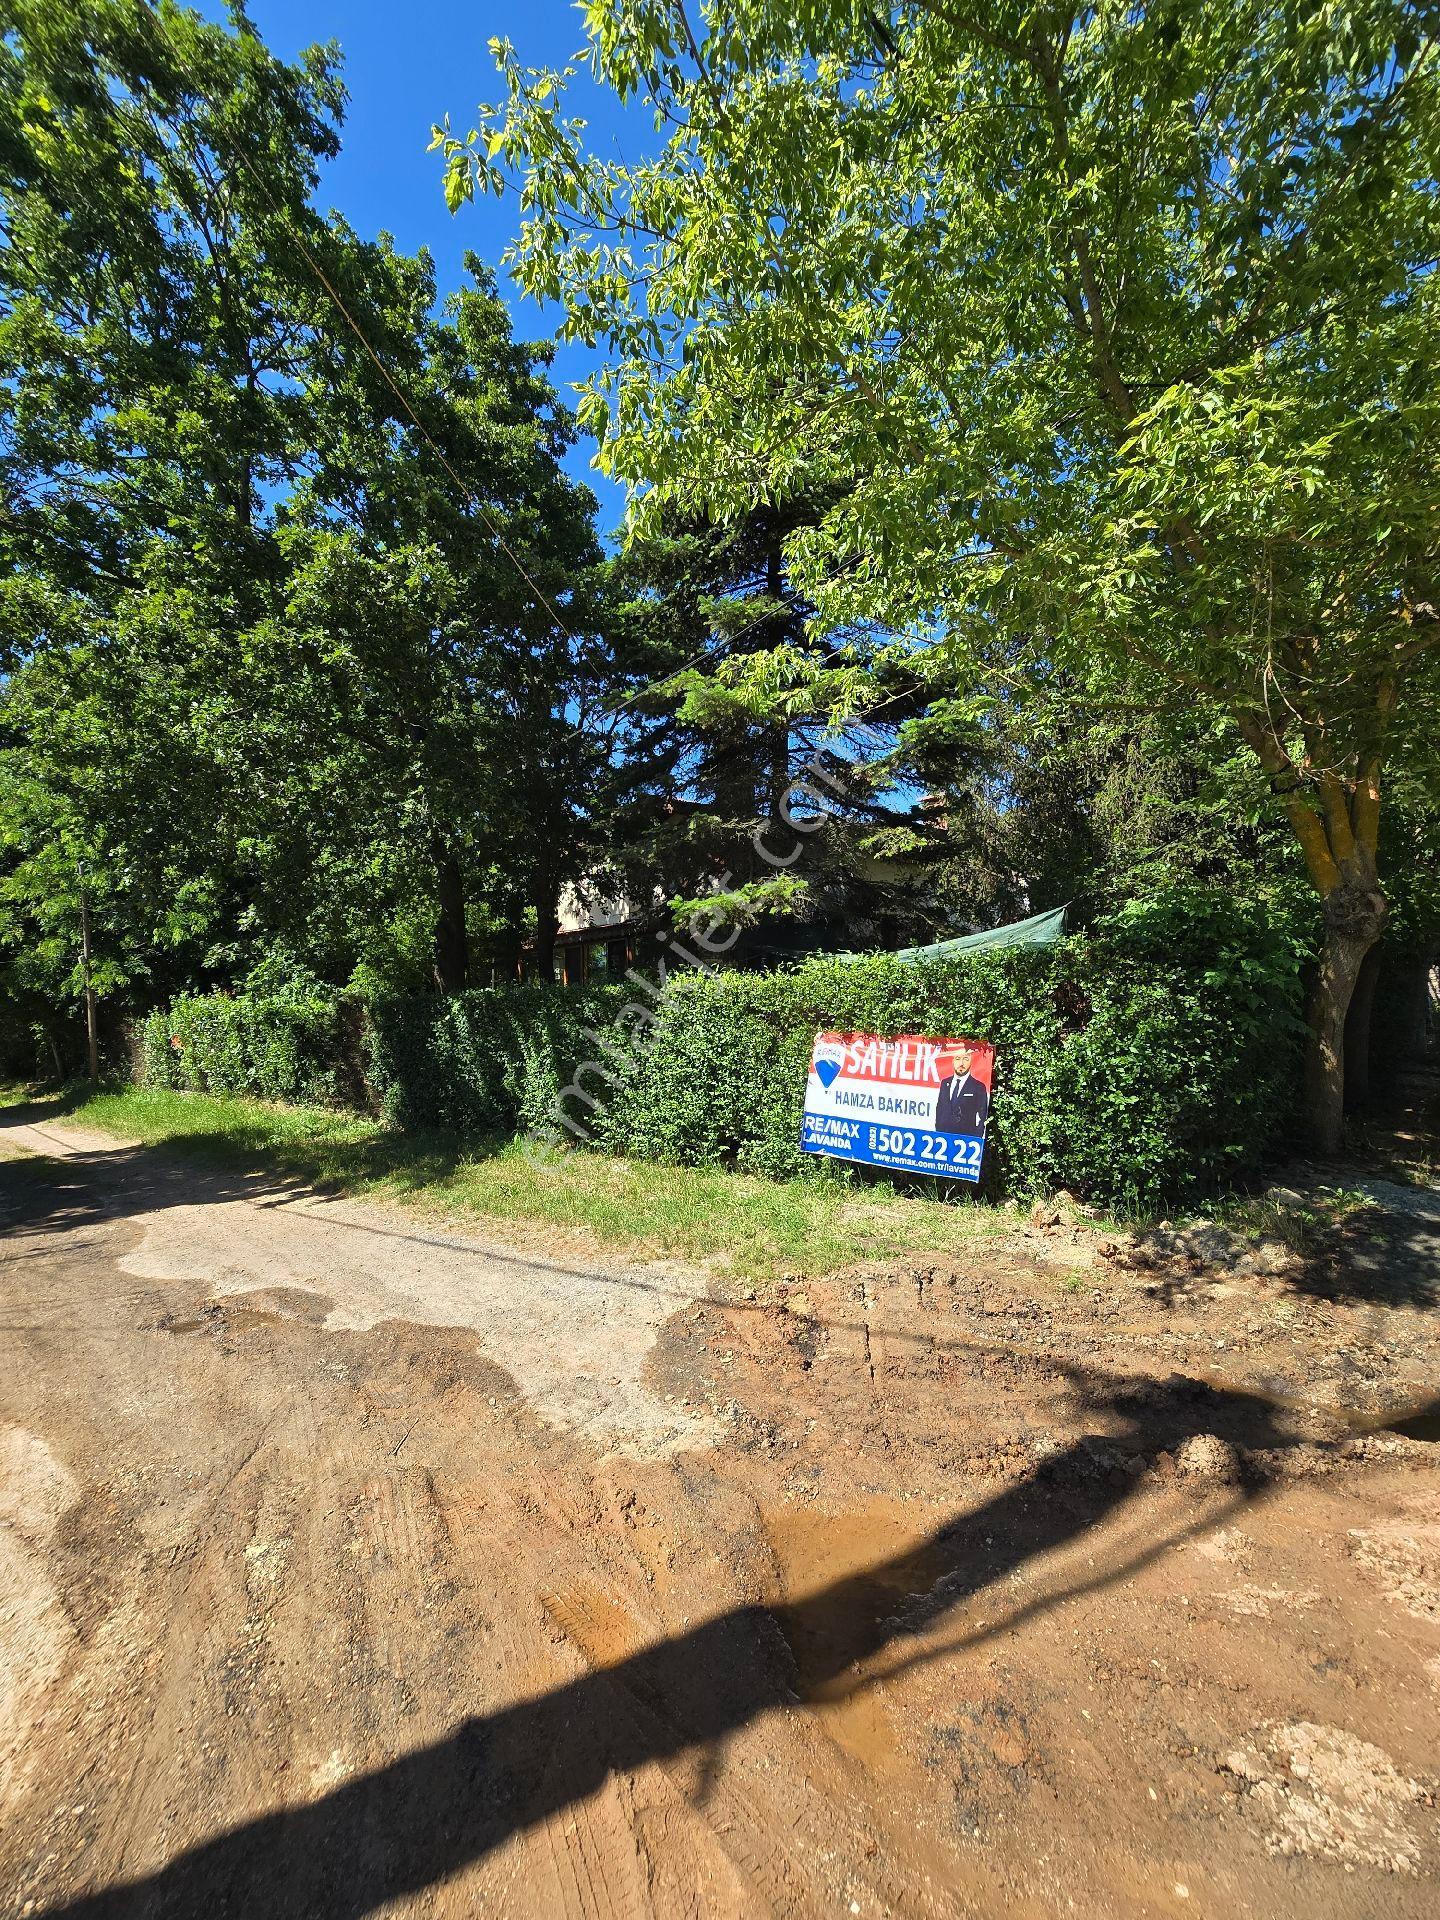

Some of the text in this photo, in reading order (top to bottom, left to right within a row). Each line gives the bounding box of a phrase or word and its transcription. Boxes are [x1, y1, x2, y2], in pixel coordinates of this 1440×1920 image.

[847, 1040, 941, 1083] SATILIK
[835, 1090, 931, 1117] HAMZA BAKIRCI
[804, 1115, 860, 1139] RE/MAX
[803, 1132, 852, 1150] LAVANDA
[878, 1128, 981, 1166] 502 22 22
